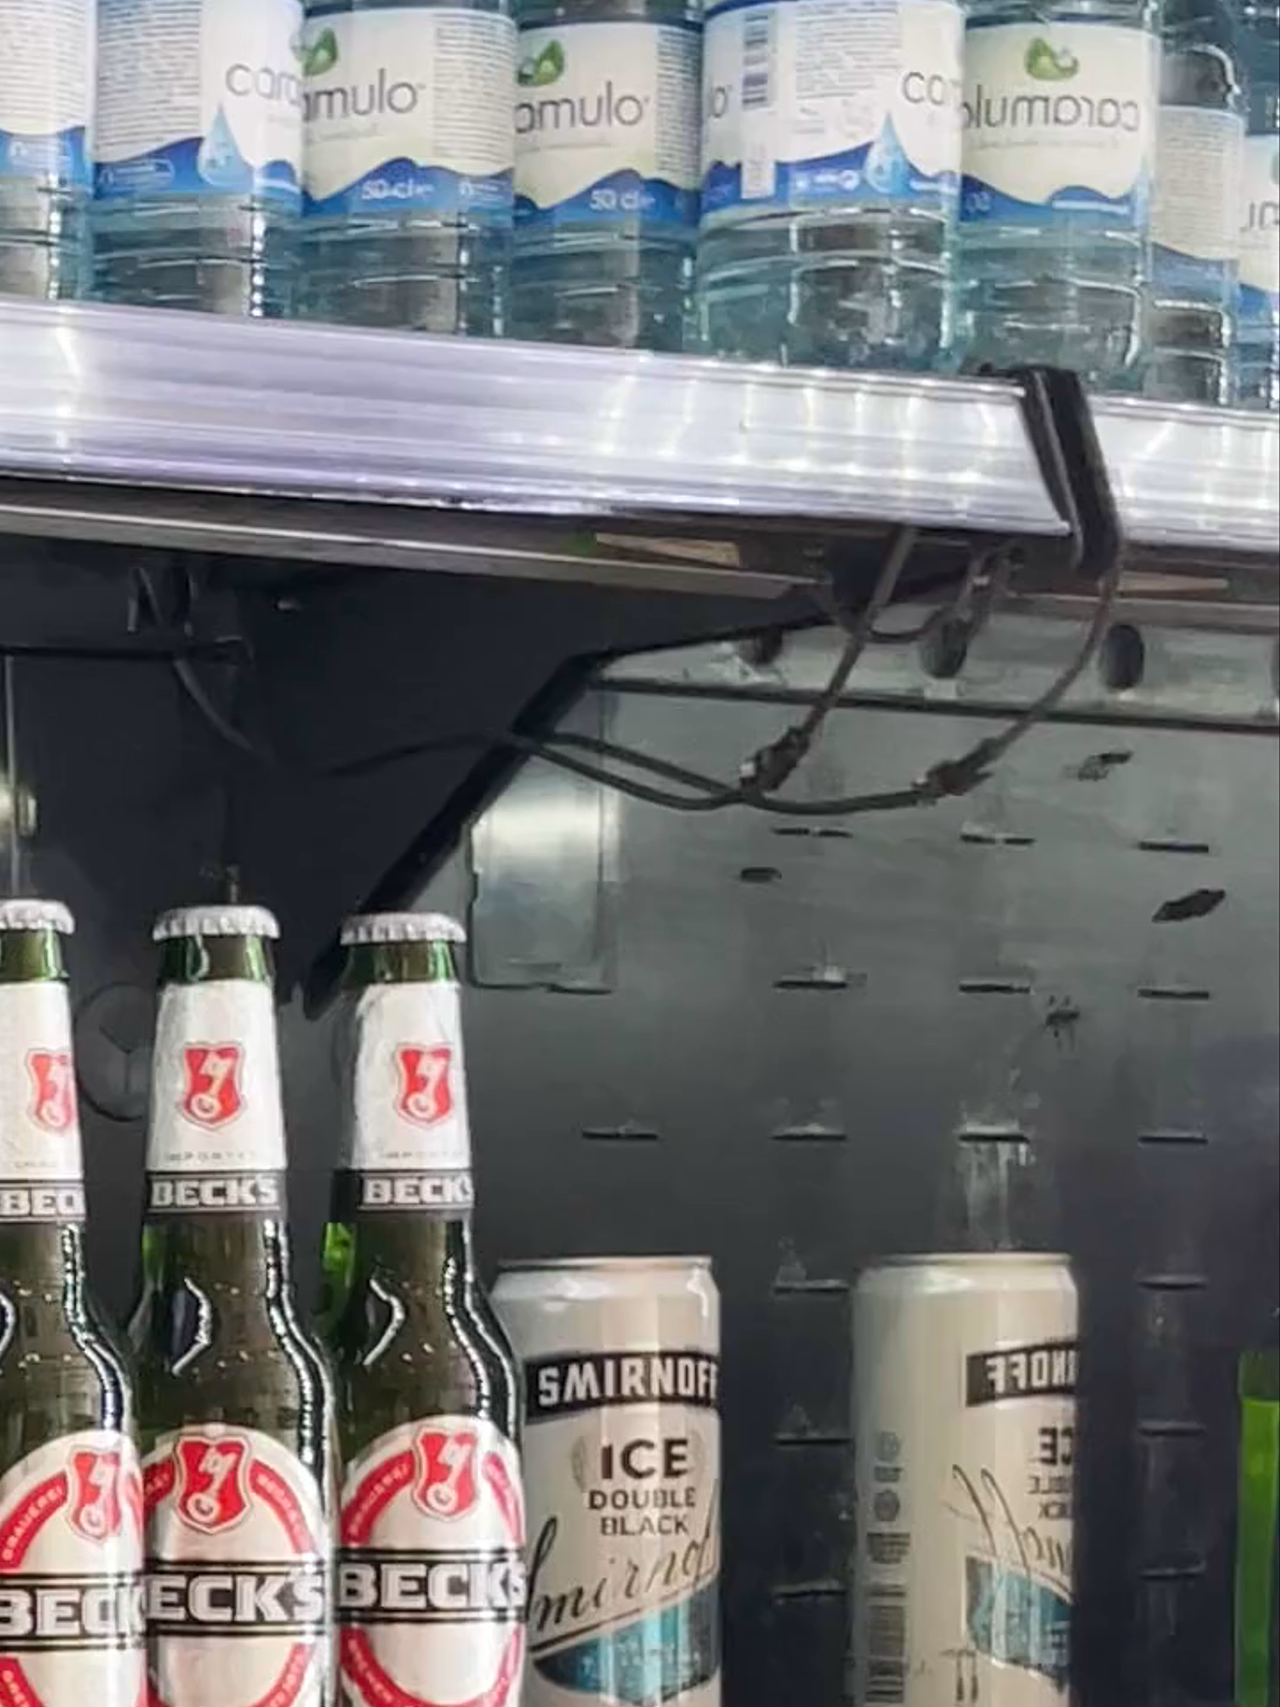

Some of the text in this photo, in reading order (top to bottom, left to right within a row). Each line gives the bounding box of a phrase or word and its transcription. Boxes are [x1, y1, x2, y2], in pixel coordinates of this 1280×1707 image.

[539, 1357, 718, 1407] SMIRNOFF
[601, 1439, 689, 1481] ICE
[589, 1487, 696, 1510] DOUBLE
[600, 1514, 690, 1536] BLACK
